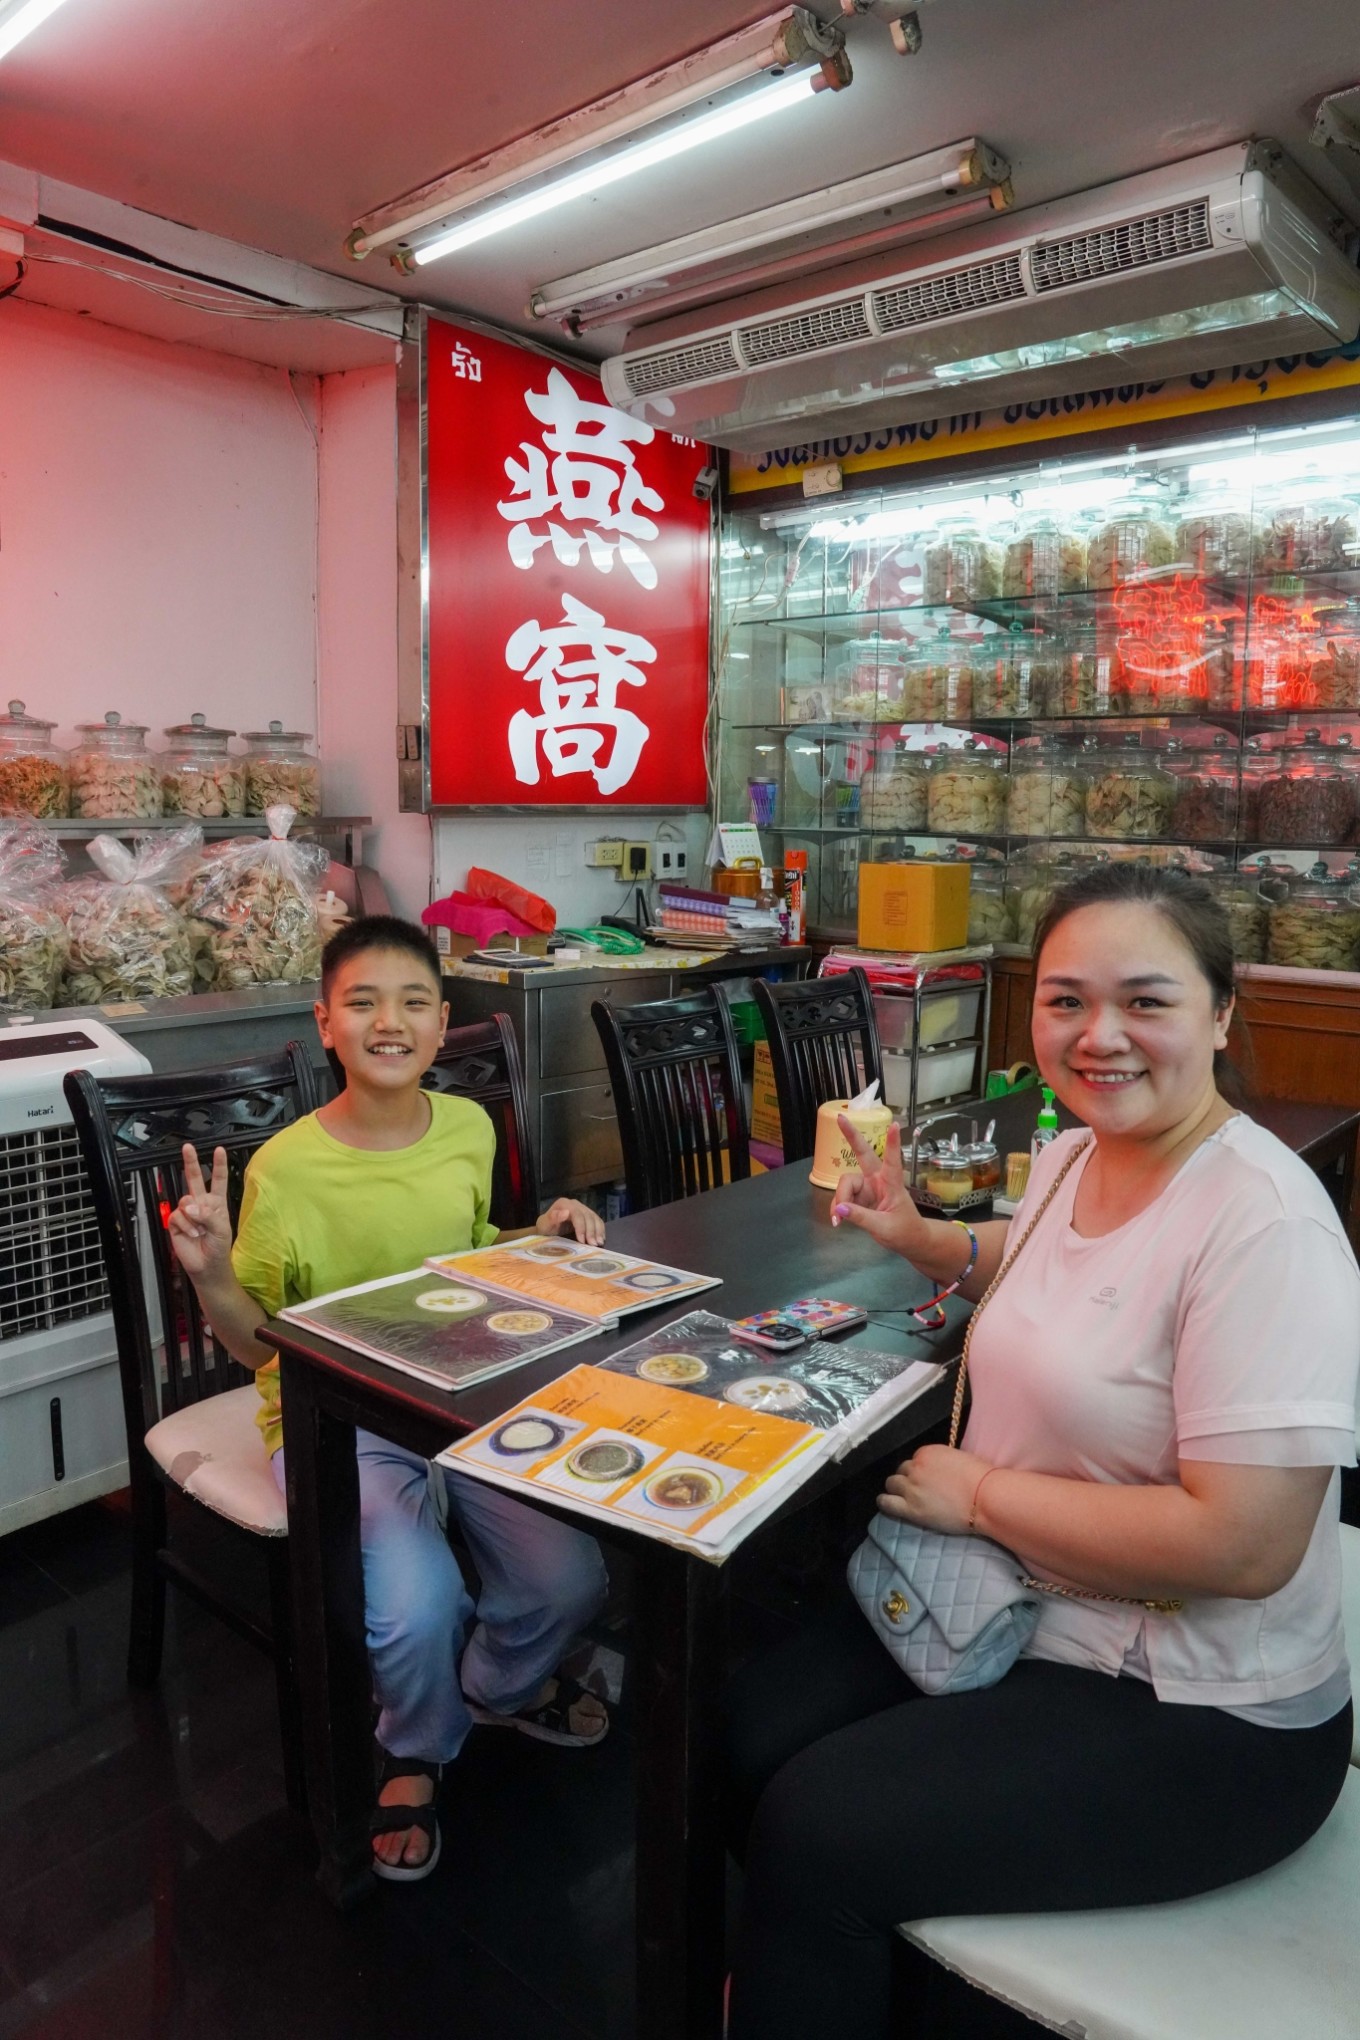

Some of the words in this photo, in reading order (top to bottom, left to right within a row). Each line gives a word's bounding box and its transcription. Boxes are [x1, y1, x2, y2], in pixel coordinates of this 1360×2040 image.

[451, 341, 482, 382] รัง
[497, 367, 664, 796] 燕窩
[27, 1105, 54, 1118] Hatari
